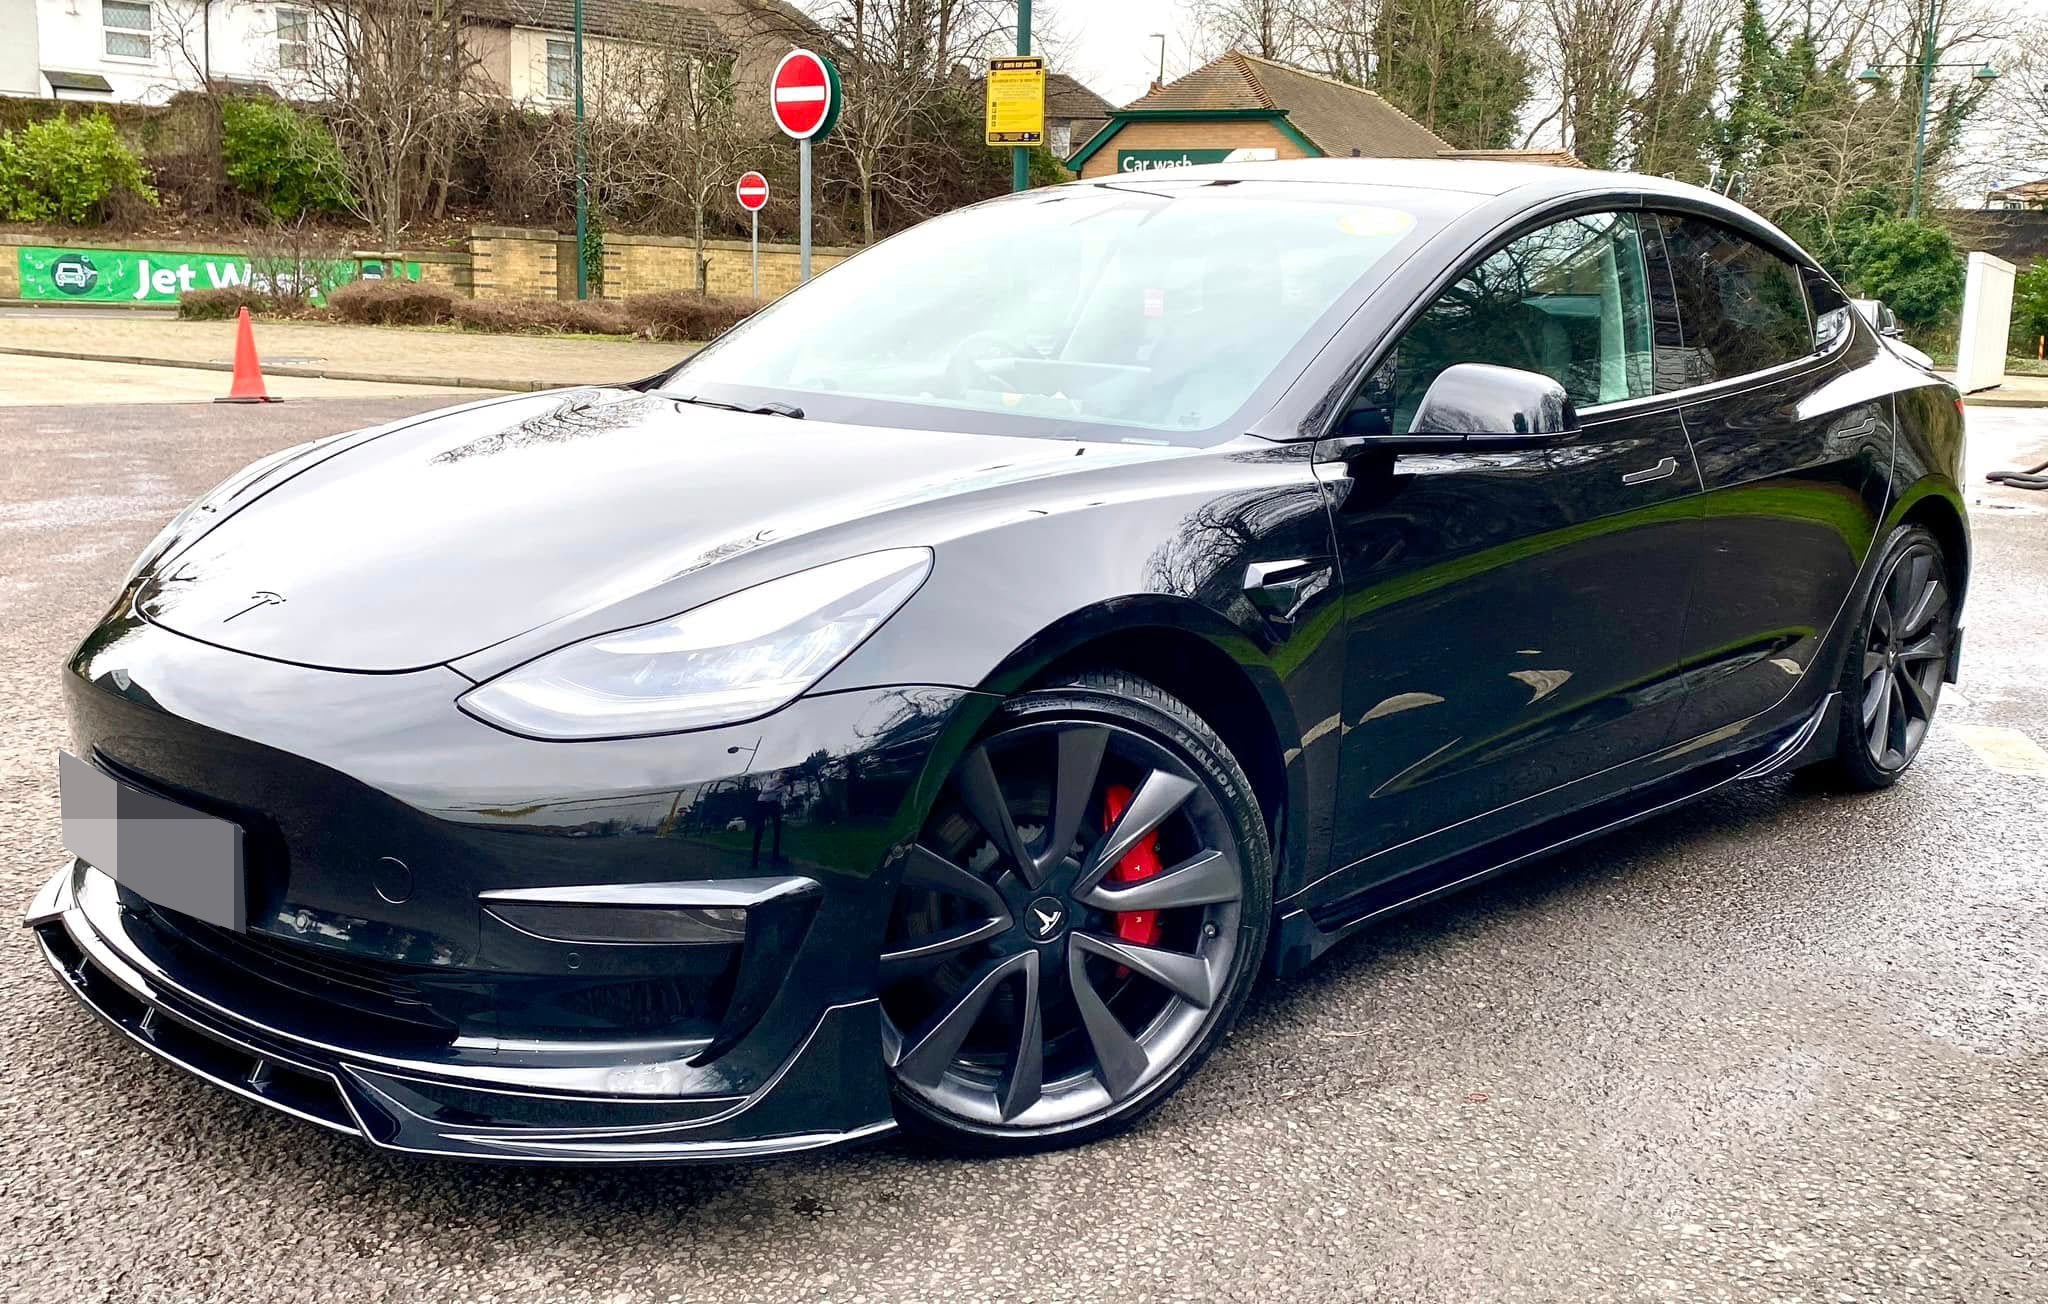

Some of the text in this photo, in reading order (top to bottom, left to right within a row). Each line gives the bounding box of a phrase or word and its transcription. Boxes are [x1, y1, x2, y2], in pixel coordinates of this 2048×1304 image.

[1122, 154, 1193, 172] Car wash
[133, 259, 319, 299] Jet Wash
